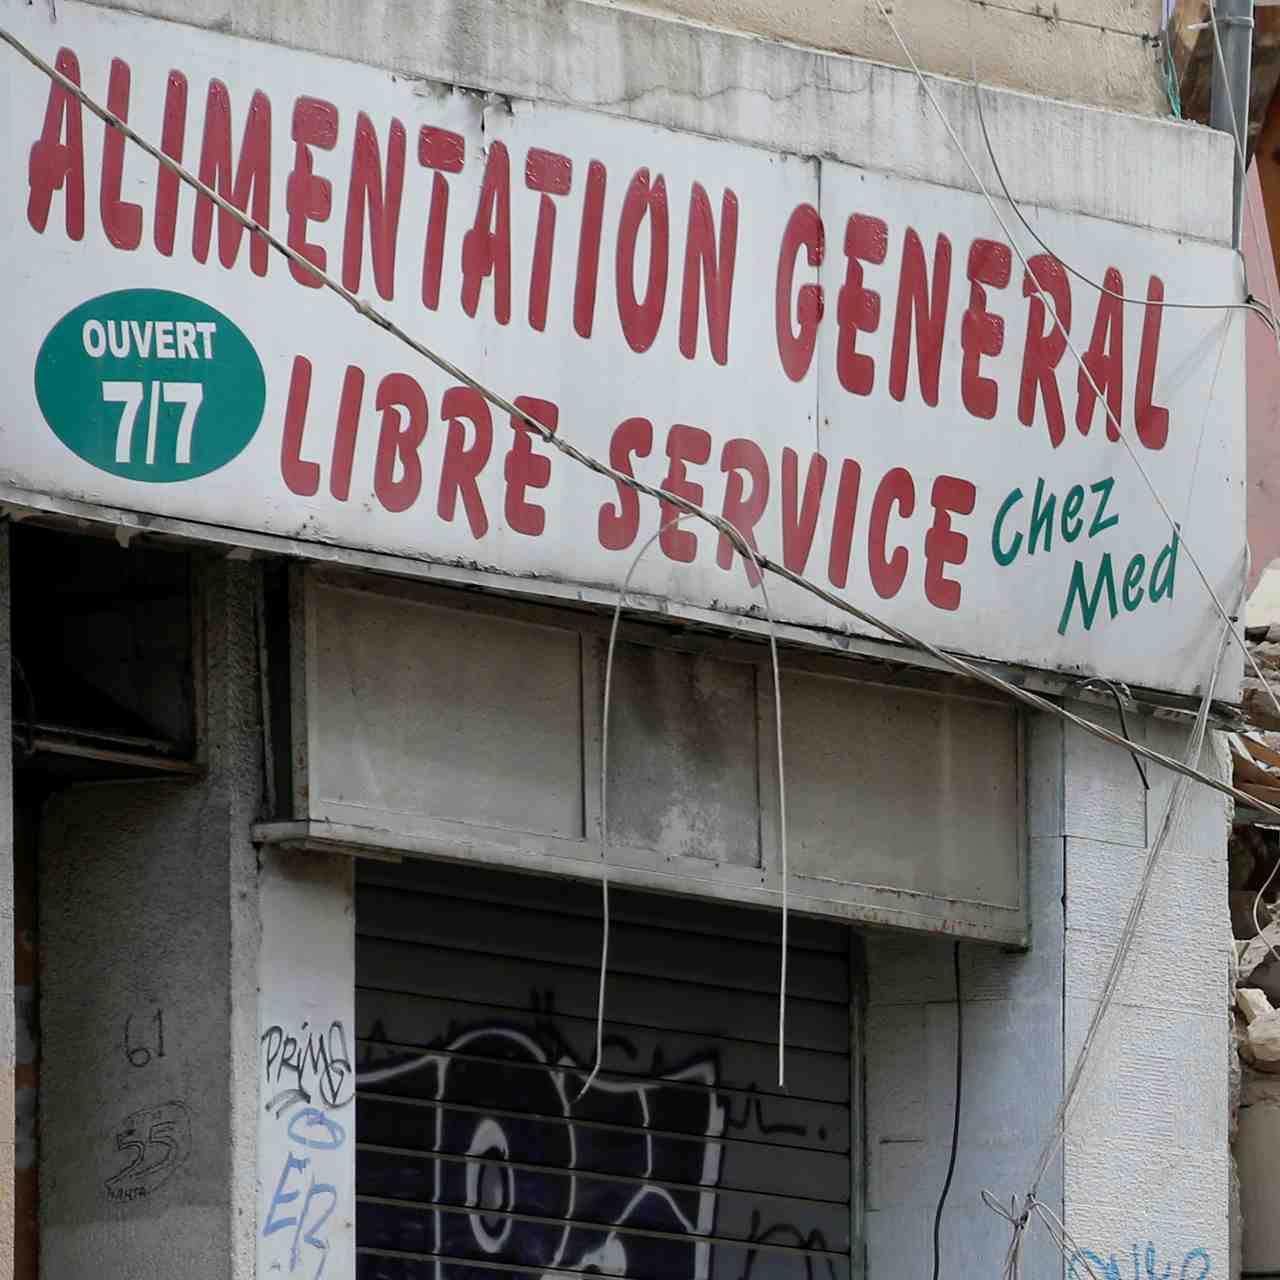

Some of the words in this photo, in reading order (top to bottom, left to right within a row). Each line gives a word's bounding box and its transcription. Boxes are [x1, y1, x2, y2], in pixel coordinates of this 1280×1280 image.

[27, 48, 738, 366] ALIMENTATION
[776, 201, 1171, 450] GENERAL
[82, 319, 216, 360] OUVERT
[102, 380, 204, 465] 7/7
[280, 355, 560, 538] LIBRE
[598, 416, 977, 611] SERVICE
[1057, 521, 1181, 636] Med
